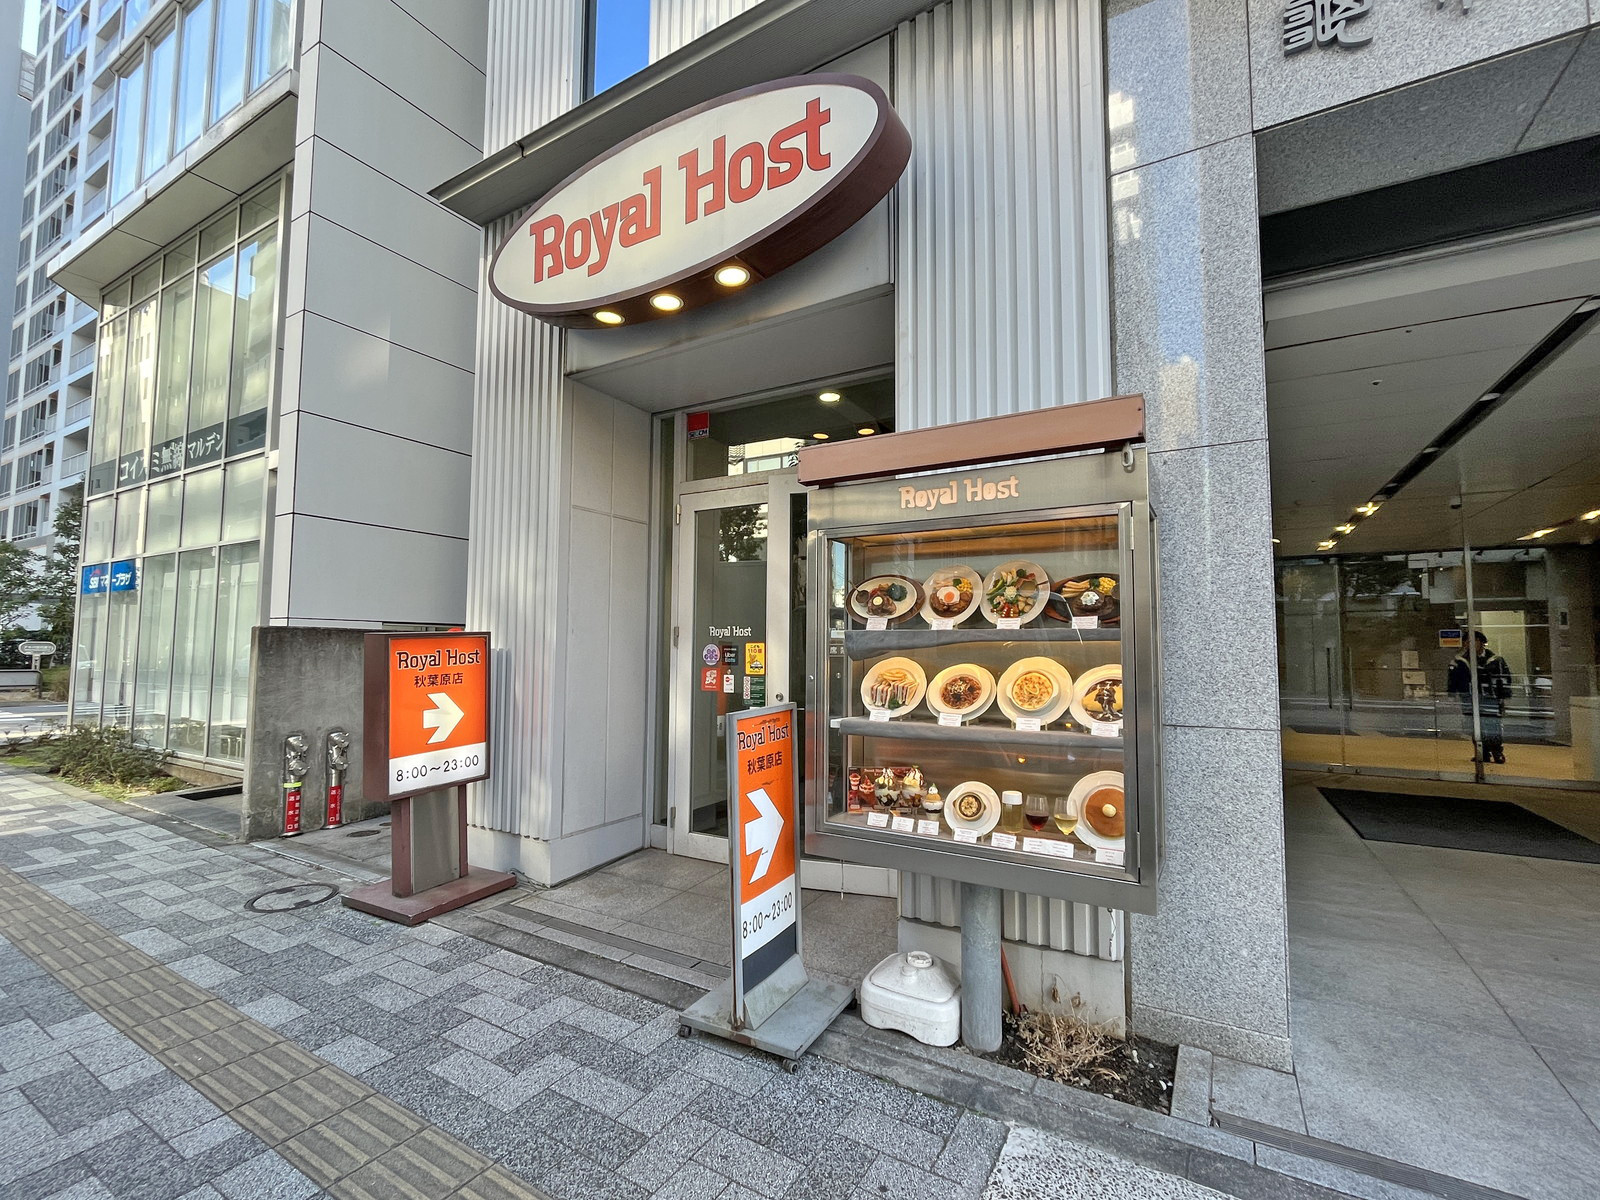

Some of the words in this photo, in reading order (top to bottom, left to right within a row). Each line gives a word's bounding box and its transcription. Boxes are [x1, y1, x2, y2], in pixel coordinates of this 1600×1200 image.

[529, 164, 662, 284] Royal
[677, 96, 832, 225] Host
[898, 480, 958, 511] Royal
[963, 475, 1019, 502] Host
[709, 626, 731, 639] Royal
[732, 626, 752, 637] Host
[396, 650, 441, 671] Royal
[446, 649, 480, 666] Host
[414, 672, 464, 688] 秋葉原店
[737, 727, 766, 750] Royal
[767, 723, 789, 743] Host
[747, 751, 783, 775] 秋葉原店
